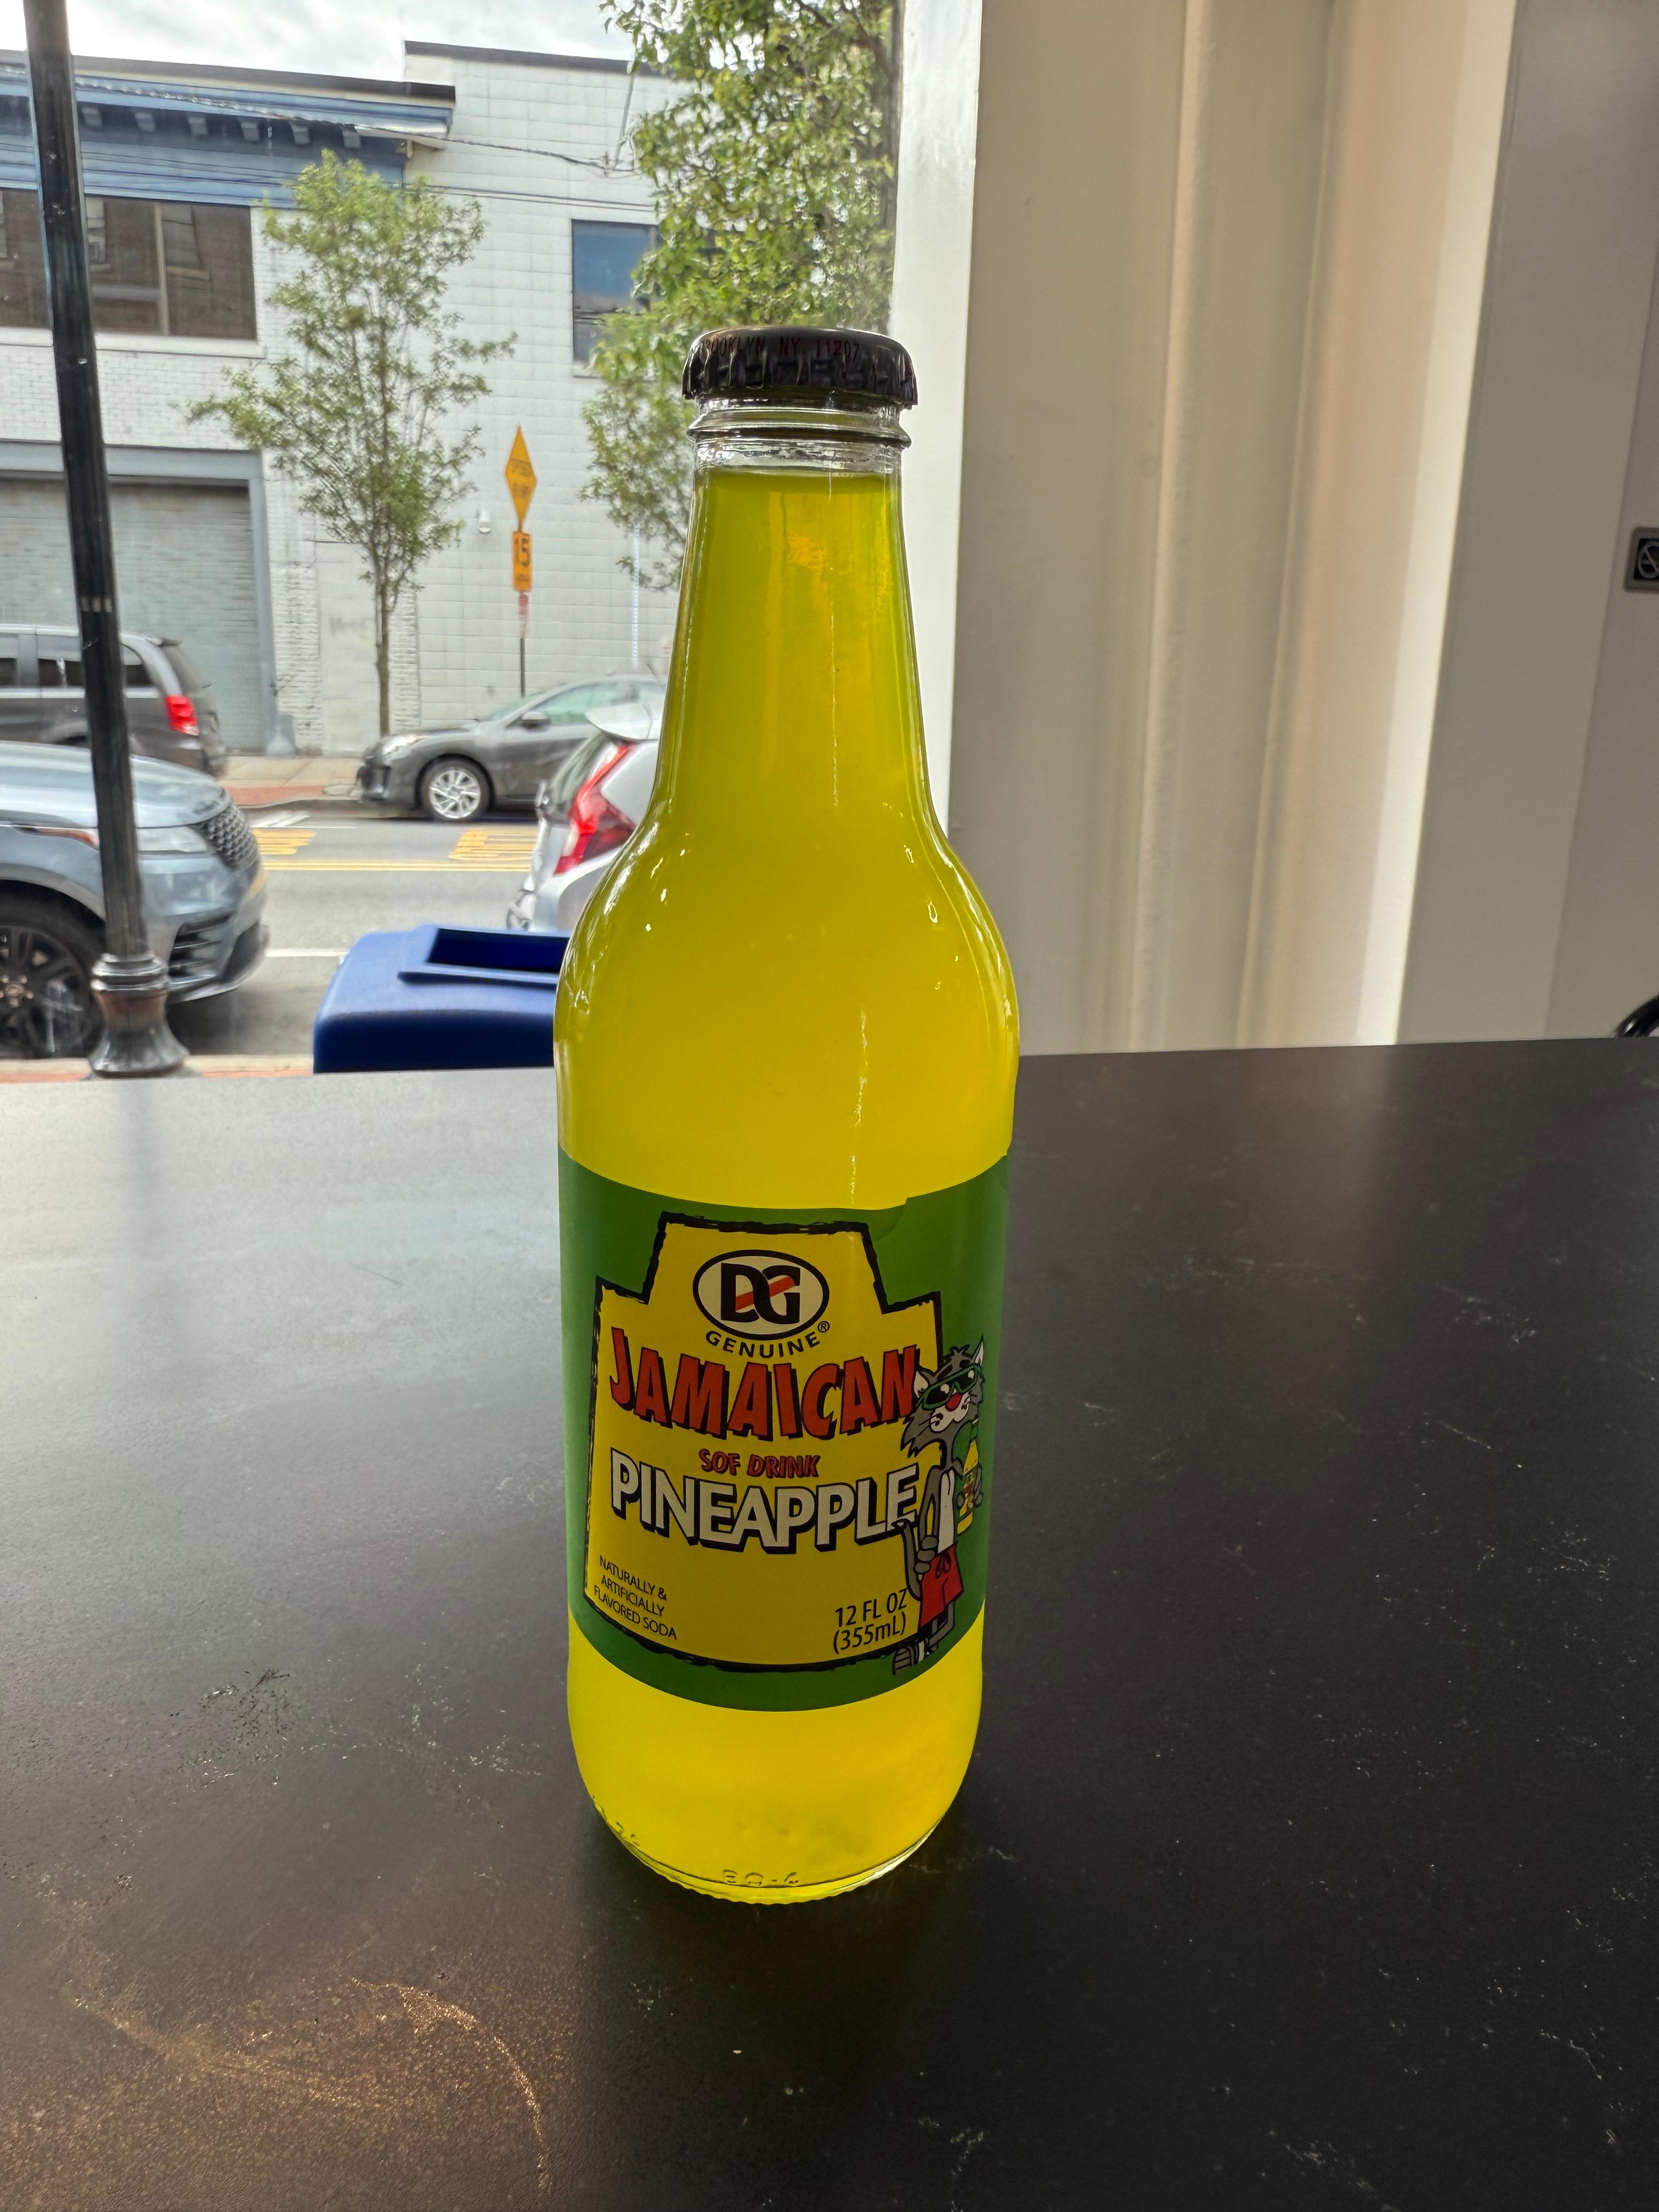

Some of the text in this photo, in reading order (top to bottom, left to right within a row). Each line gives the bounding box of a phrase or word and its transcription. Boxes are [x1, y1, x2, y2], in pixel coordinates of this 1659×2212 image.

[815, 339, 860, 363] 11207
[720, 1262, 801, 1324] DG
[609, 1326, 921, 1441] JAMAICAN
[699, 1449, 819, 1479] SOF DRINK
[610, 1448, 919, 1554] PINEAPPLE
[600, 1554, 667, 1601] NATURALLY &
[601, 1575, 665, 1617] ARTIFICIALLY
[594, 1584, 678, 1640] FLAVORED SODA
[835, 1587, 907, 1628] 12 FL OZ
[833, 1611, 906, 1655] (355mL)
